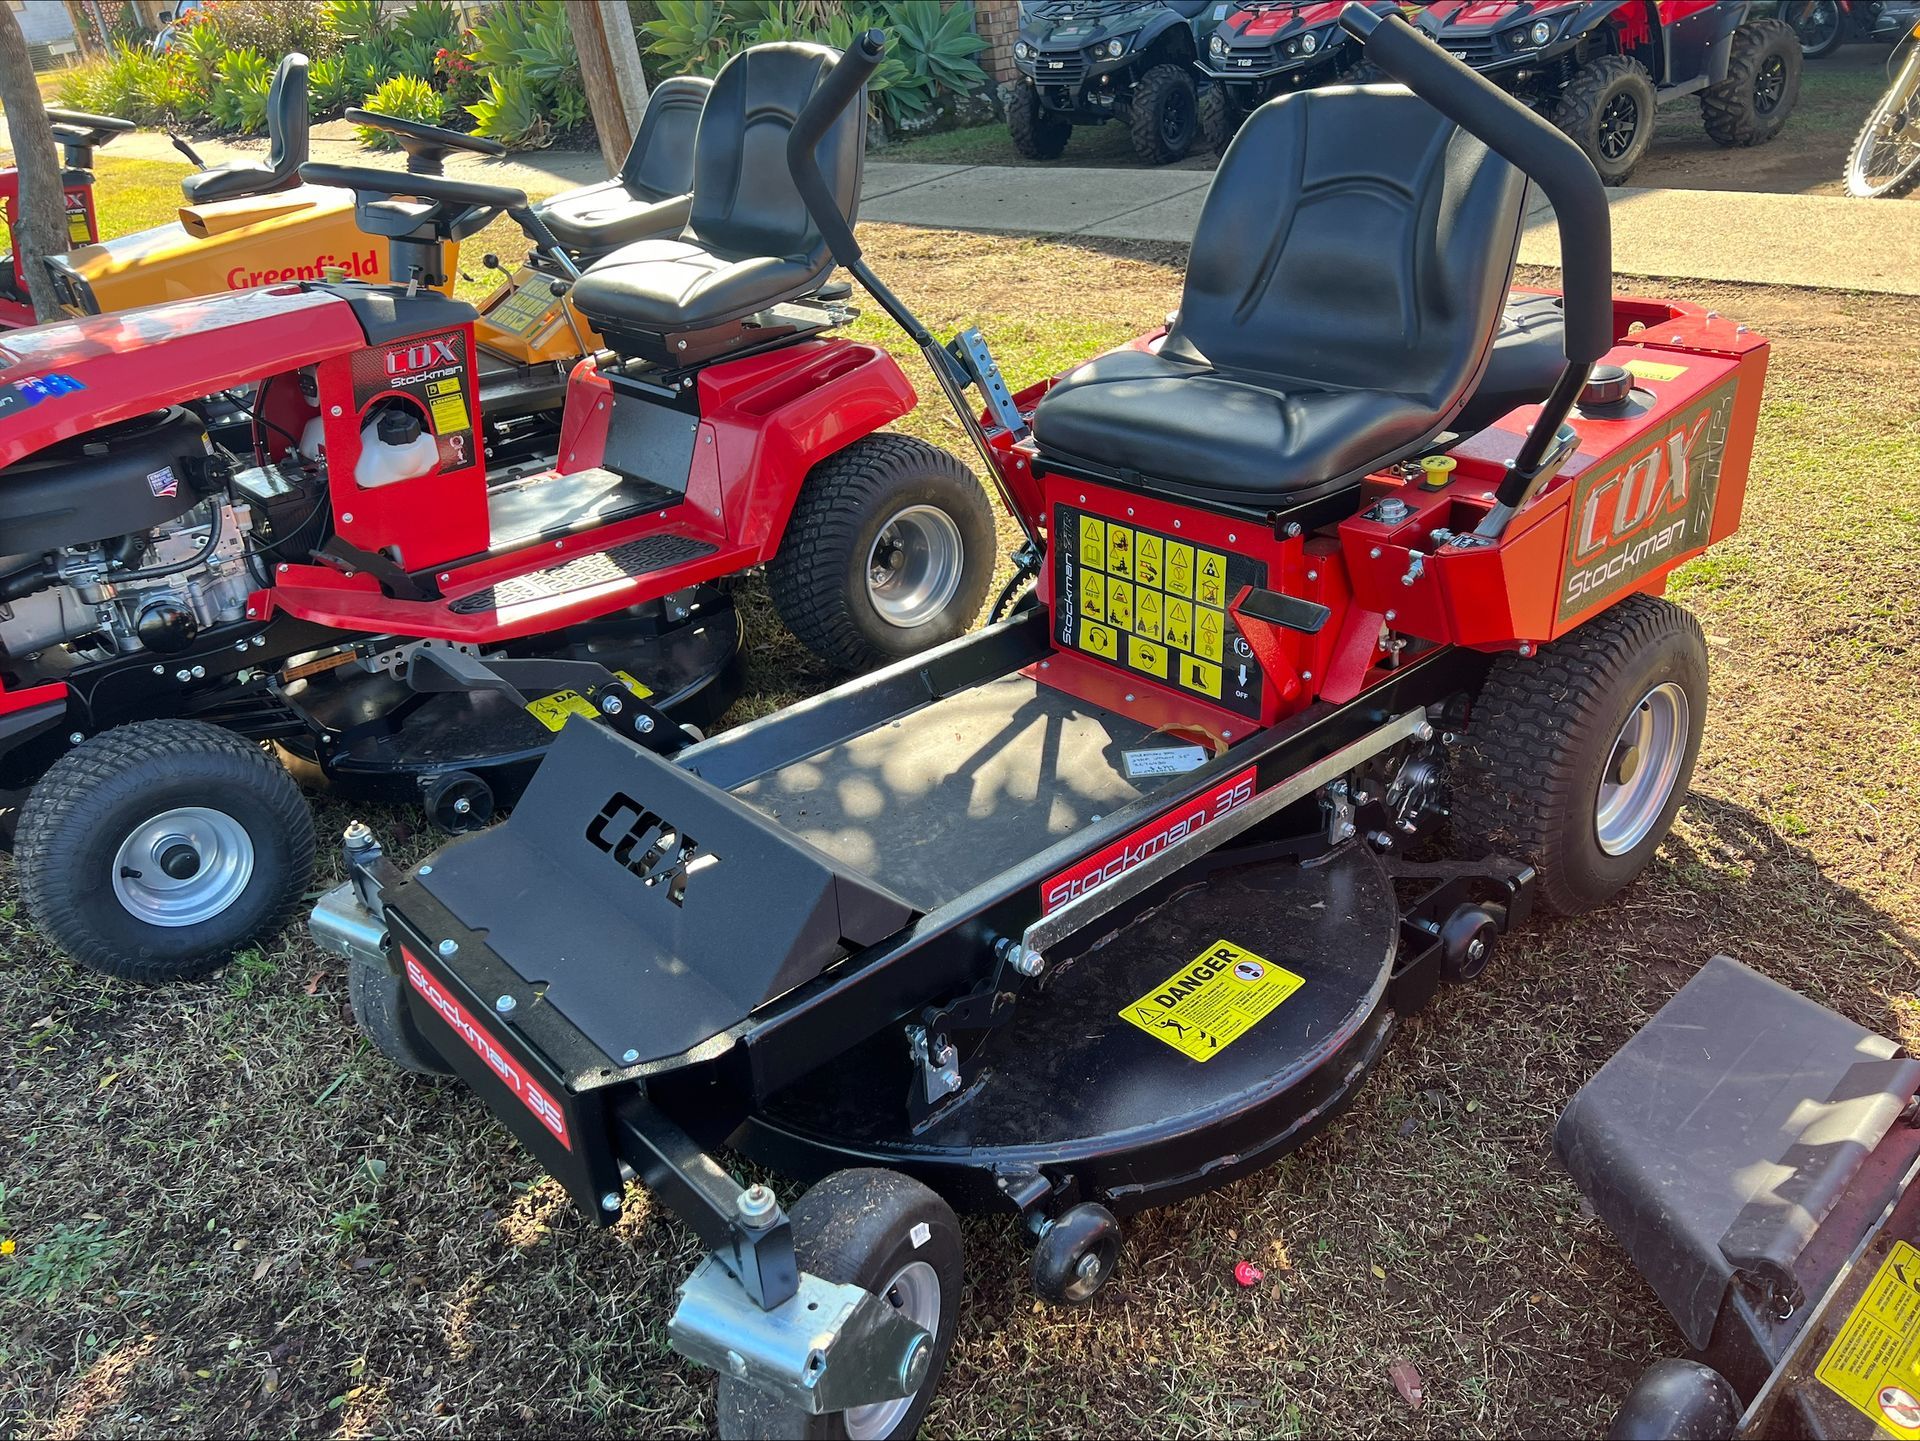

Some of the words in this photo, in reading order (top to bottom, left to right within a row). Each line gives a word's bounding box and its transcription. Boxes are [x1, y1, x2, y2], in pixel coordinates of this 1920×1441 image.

[1237, 59, 1253, 67] TGB
[227, 250, 379, 290] Greenfield
[386, 337, 459, 374] COX
[391, 365, 463, 388] Stockman
[1577, 416, 1708, 557] COX
[1566, 518, 1685, 603] Stockman
[1062, 554, 1073, 646] Stockman
[1235, 690, 1249, 699] OFF
[585, 791, 723, 908] COX
[1048, 809, 1206, 913] Stockman
[1213, 777, 1253, 818] 35
[1154, 948, 1239, 1008] DANGER
[407, 960, 521, 1090] Stockman
[525, 1082, 563, 1133] 35
